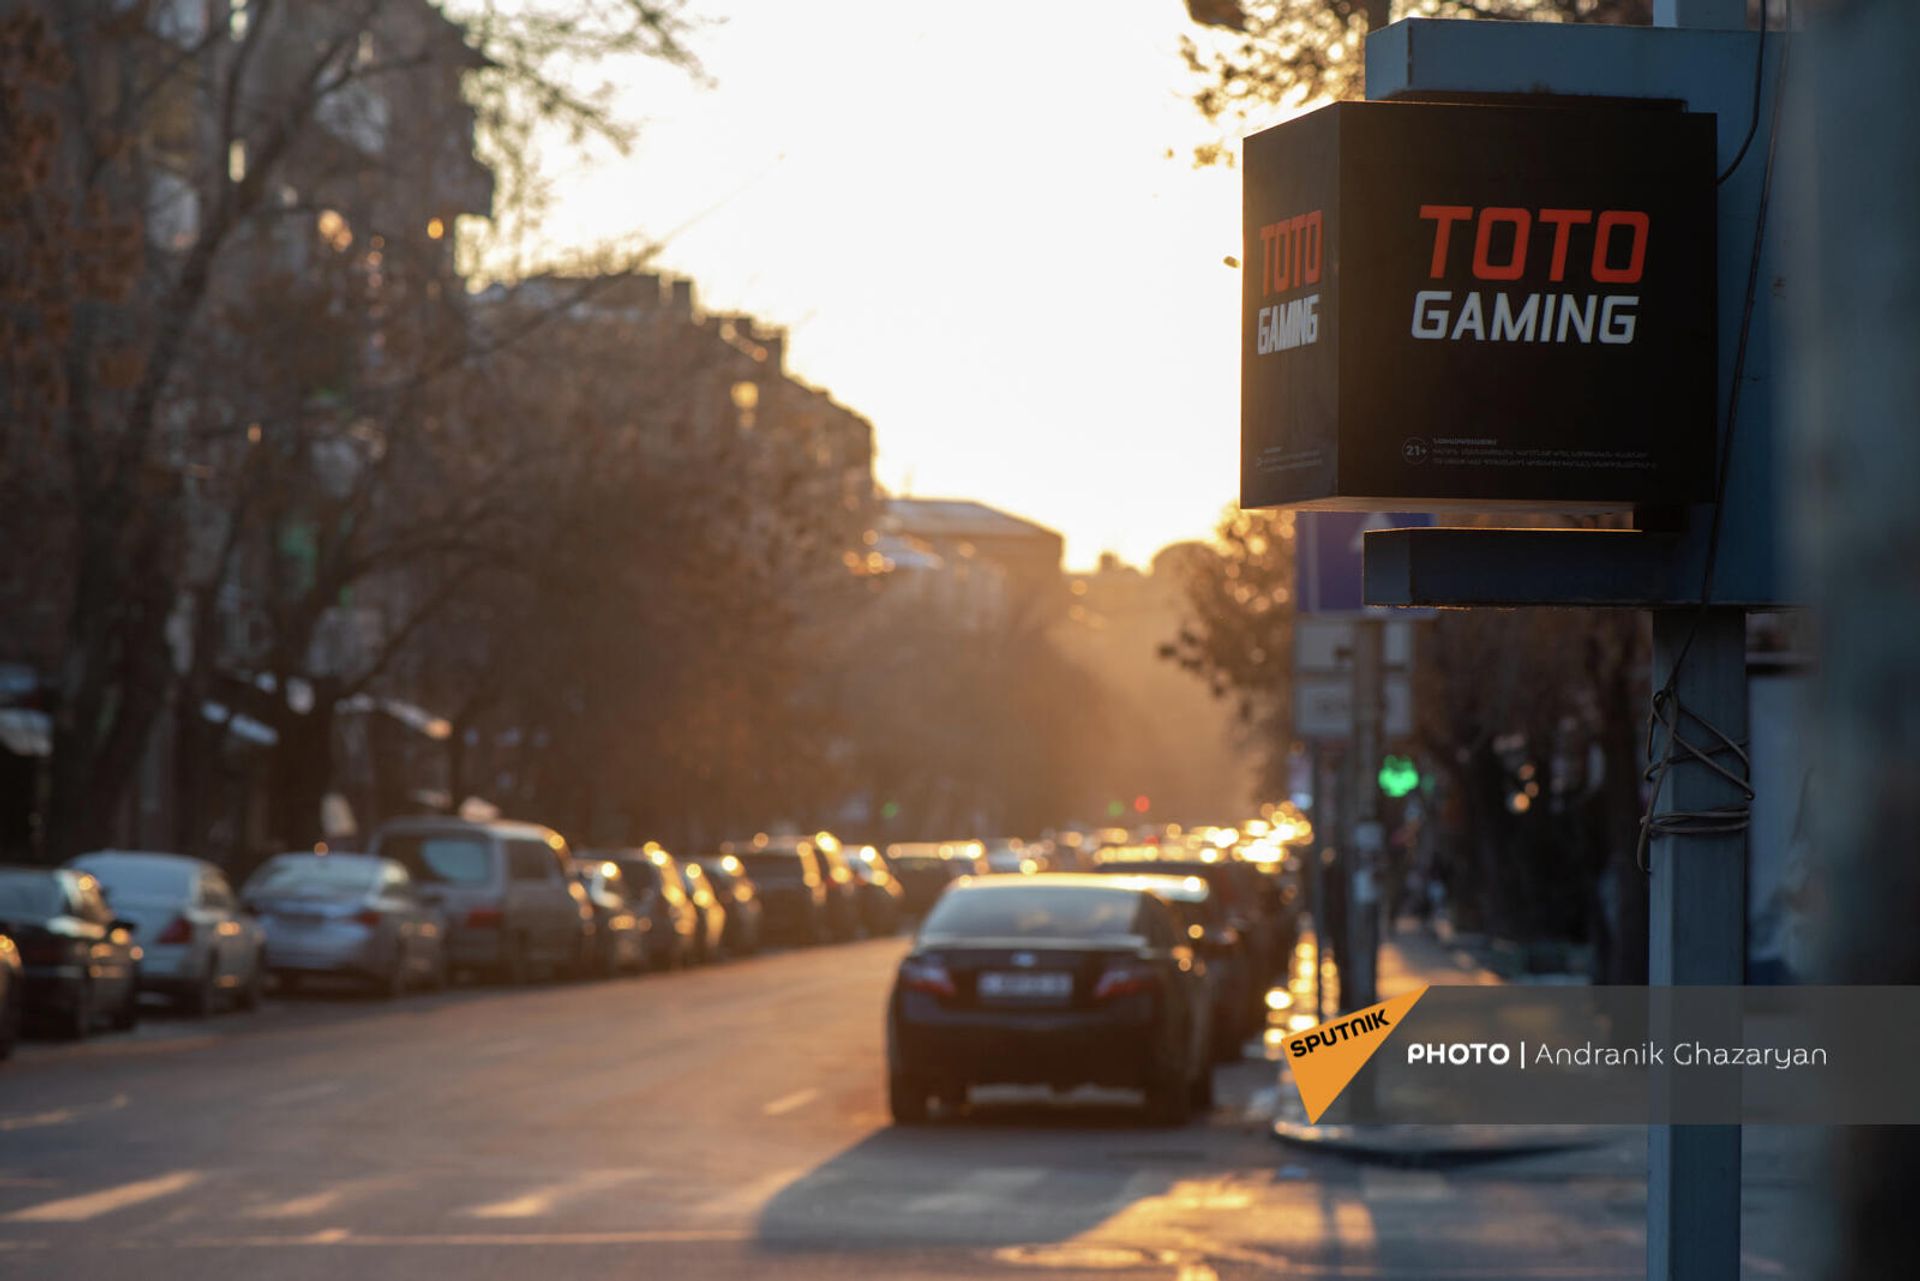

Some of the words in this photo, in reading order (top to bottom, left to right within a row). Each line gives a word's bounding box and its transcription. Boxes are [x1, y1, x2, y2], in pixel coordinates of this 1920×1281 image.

[1259, 209, 1323, 297] TOTO
[1418, 204, 1651, 284] TOTO
[1257, 294, 1320, 356] GAMING
[1411, 290, 1640, 345] GAMING
[1406, 444, 1427, 457] 21+
